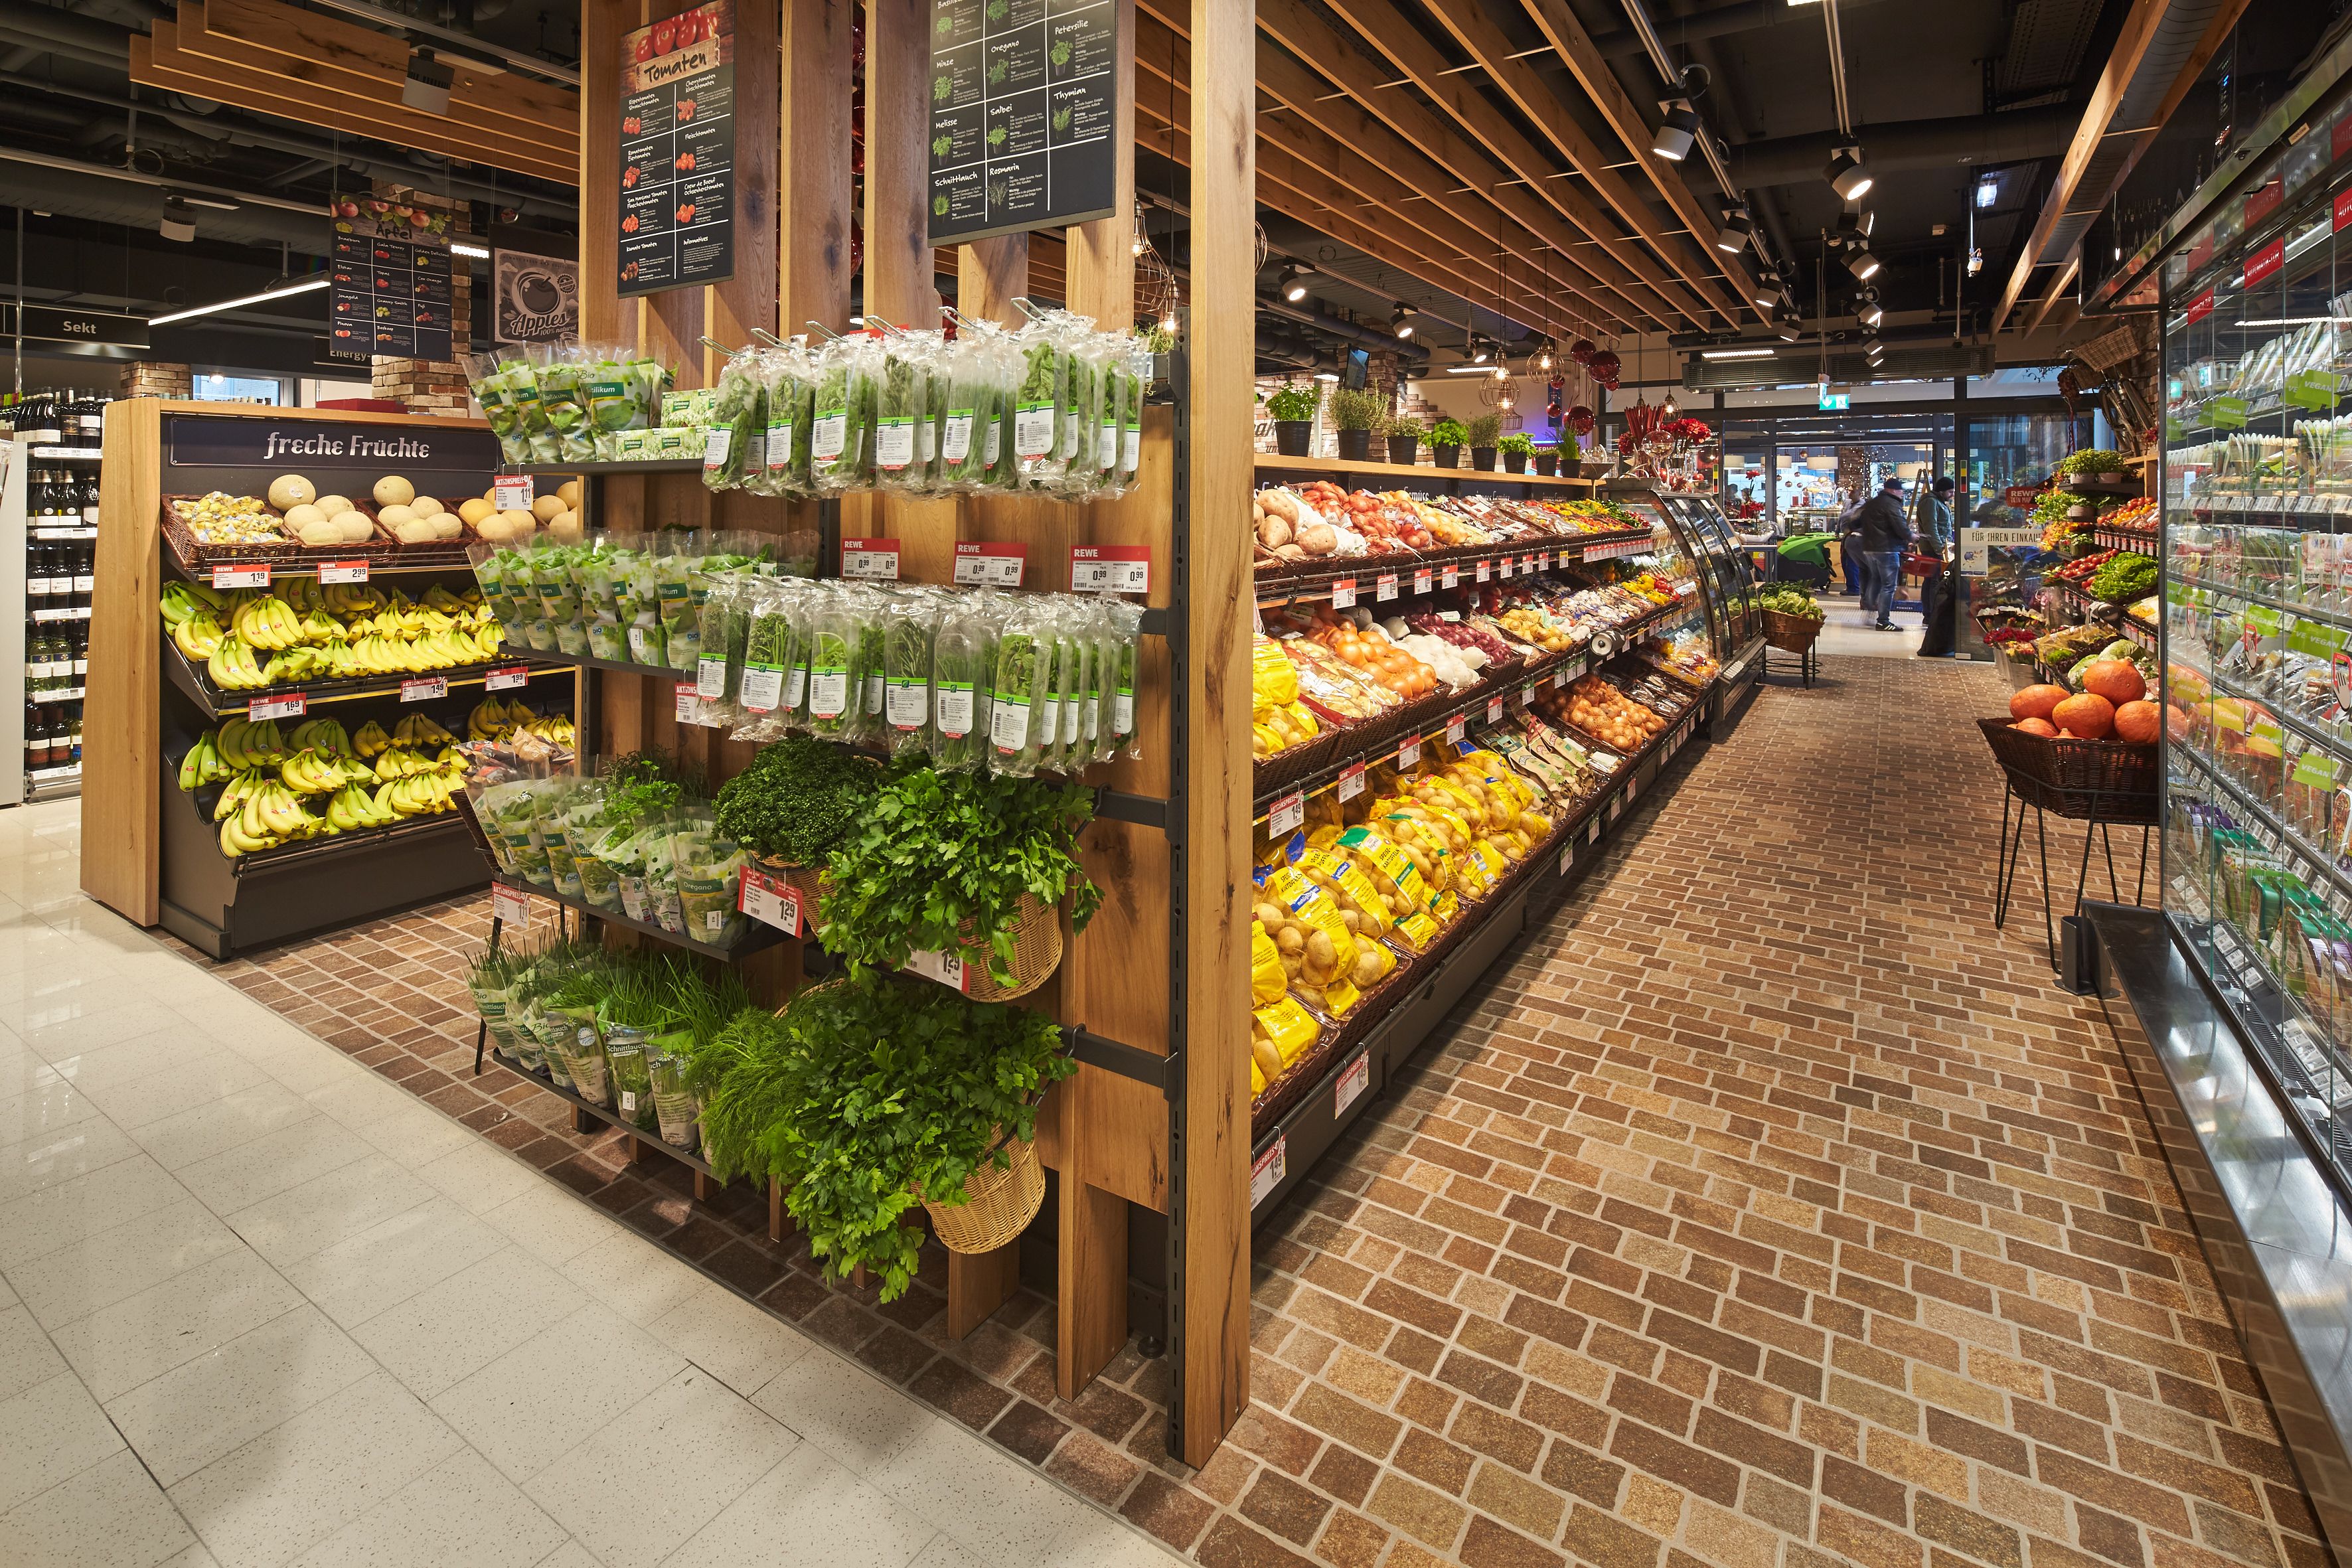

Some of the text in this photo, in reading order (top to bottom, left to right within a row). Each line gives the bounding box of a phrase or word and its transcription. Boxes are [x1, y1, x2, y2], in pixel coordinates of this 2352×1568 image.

[1055, 20, 1089, 35] Petersilie
[991, 40, 1020, 52] Oregano
[644, 53, 707, 83] Tomaten
[937, 59, 954, 68] Minze
[1054, 88, 1086, 100] Thymian
[990, 104, 1012, 116] Salbei
[935, 118, 958, 129] Melisse
[685, 128, 716, 140] Fleischtomaten
[989, 163, 1020, 176] Rosmarin
[935, 171, 978, 187] Schnittlauch
[376, 220, 413, 240] Äpfel
[683, 236, 709, 246] Informatives
[63, 321, 96, 335] Sekt
[510, 312, 569, 337] Apples
[330, 351, 371, 361] Energy-
[2304, 380, 2331, 392] VEGAN
[2219, 406, 2242, 415] VEGAN
[264, 431, 430, 459] freche Früchte
[520, 488, 530, 503] 1.11
[1972, 531, 1984, 542] FÜR
[1988, 532, 2009, 542] IHREN
[1074, 548, 1098, 557] REWE
[858, 559, 869, 568] 0.99
[886, 560, 895, 570] 0.99
[973, 565, 985, 574] 0.99
[250, 572, 265, 582] 1.19
[353, 568, 366, 578] 2.99
[1005, 566, 1018, 576] 0.99
[1093, 570, 1107, 581] 0.99
[1130, 571, 1143, 582] 0.99
[2310, 637, 2339, 649] VEGAN
[402, 678, 436, 687] AKTIONSPREIS
[511, 674, 523, 683] 1.99
[431, 684, 444, 694] 1.49
[285, 700, 299, 712] 1.69
[2301, 763, 2329, 778] VEGAN
[1270, 796, 1295, 814] AKTIONSPREIS
[1291, 803, 1301, 821] 1.49
[1379, 847, 1391, 861] SPEISE-
[1383, 848, 1400, 870] KARTOFFELN
[677, 864, 692, 876] Bio
[683, 882, 712, 891] Oregano
[779, 900, 795, 921] 1.29
[607, 1043, 646, 1053] Schnittlauch
[1336, 1061, 1360, 1091] AKTIONSPREIS
[1357, 1063, 1366, 1086] 1.49
[1251, 1148, 1275, 1177] TIONSPREIS
[1269, 1153, 1282, 1179] 1.49
